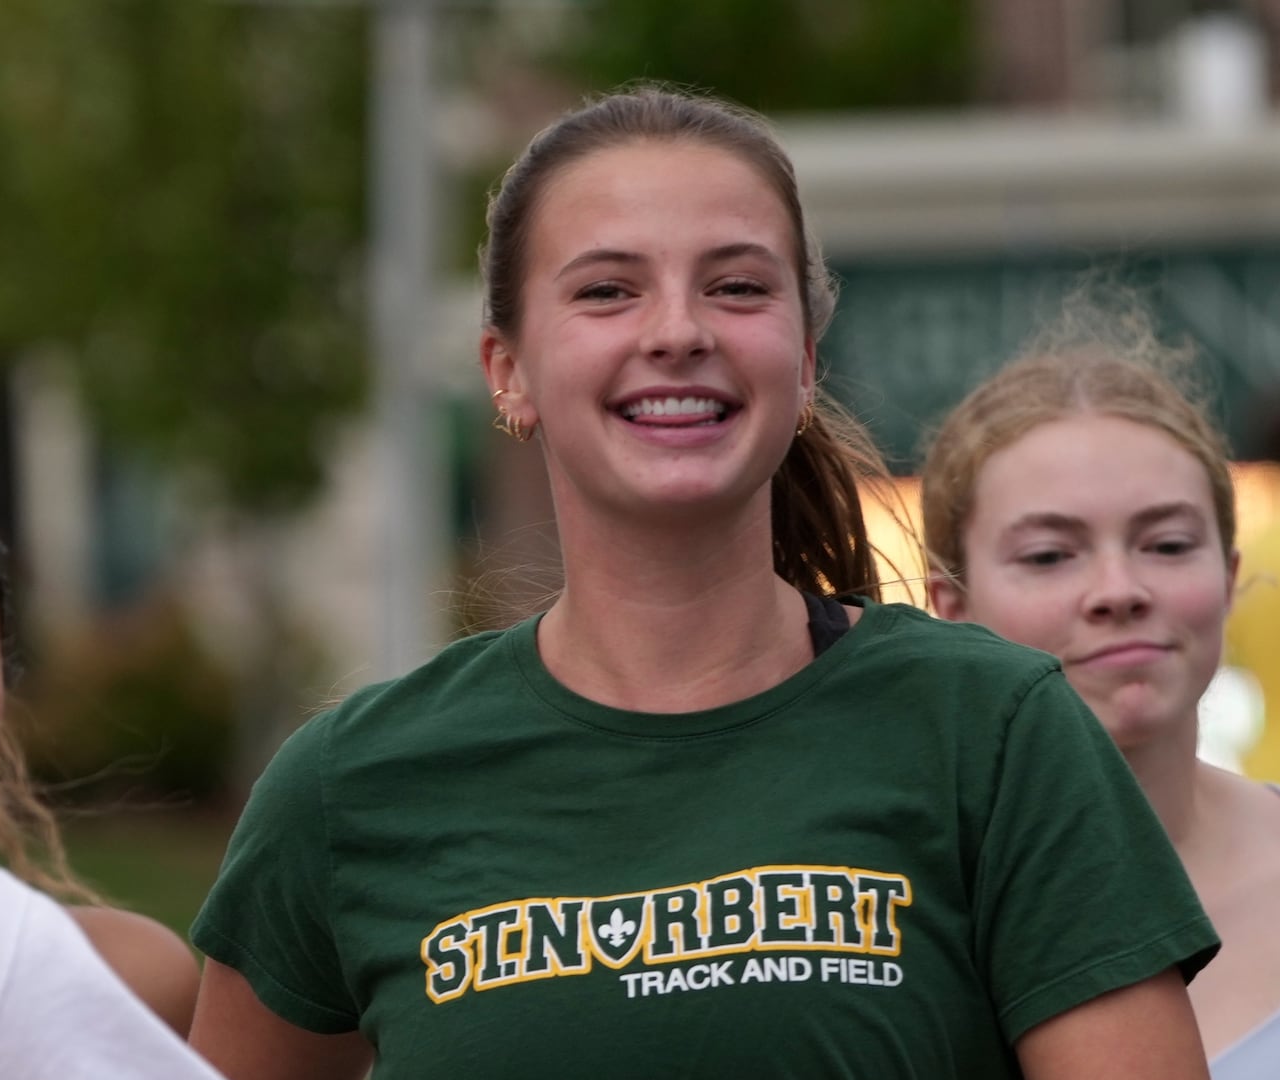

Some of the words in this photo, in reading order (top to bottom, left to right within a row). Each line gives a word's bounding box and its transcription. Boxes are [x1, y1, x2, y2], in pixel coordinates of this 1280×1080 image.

[620, 961, 733, 998] TRACK
[740, 957, 812, 985] AND
[820, 957, 903, 987] FIELD
